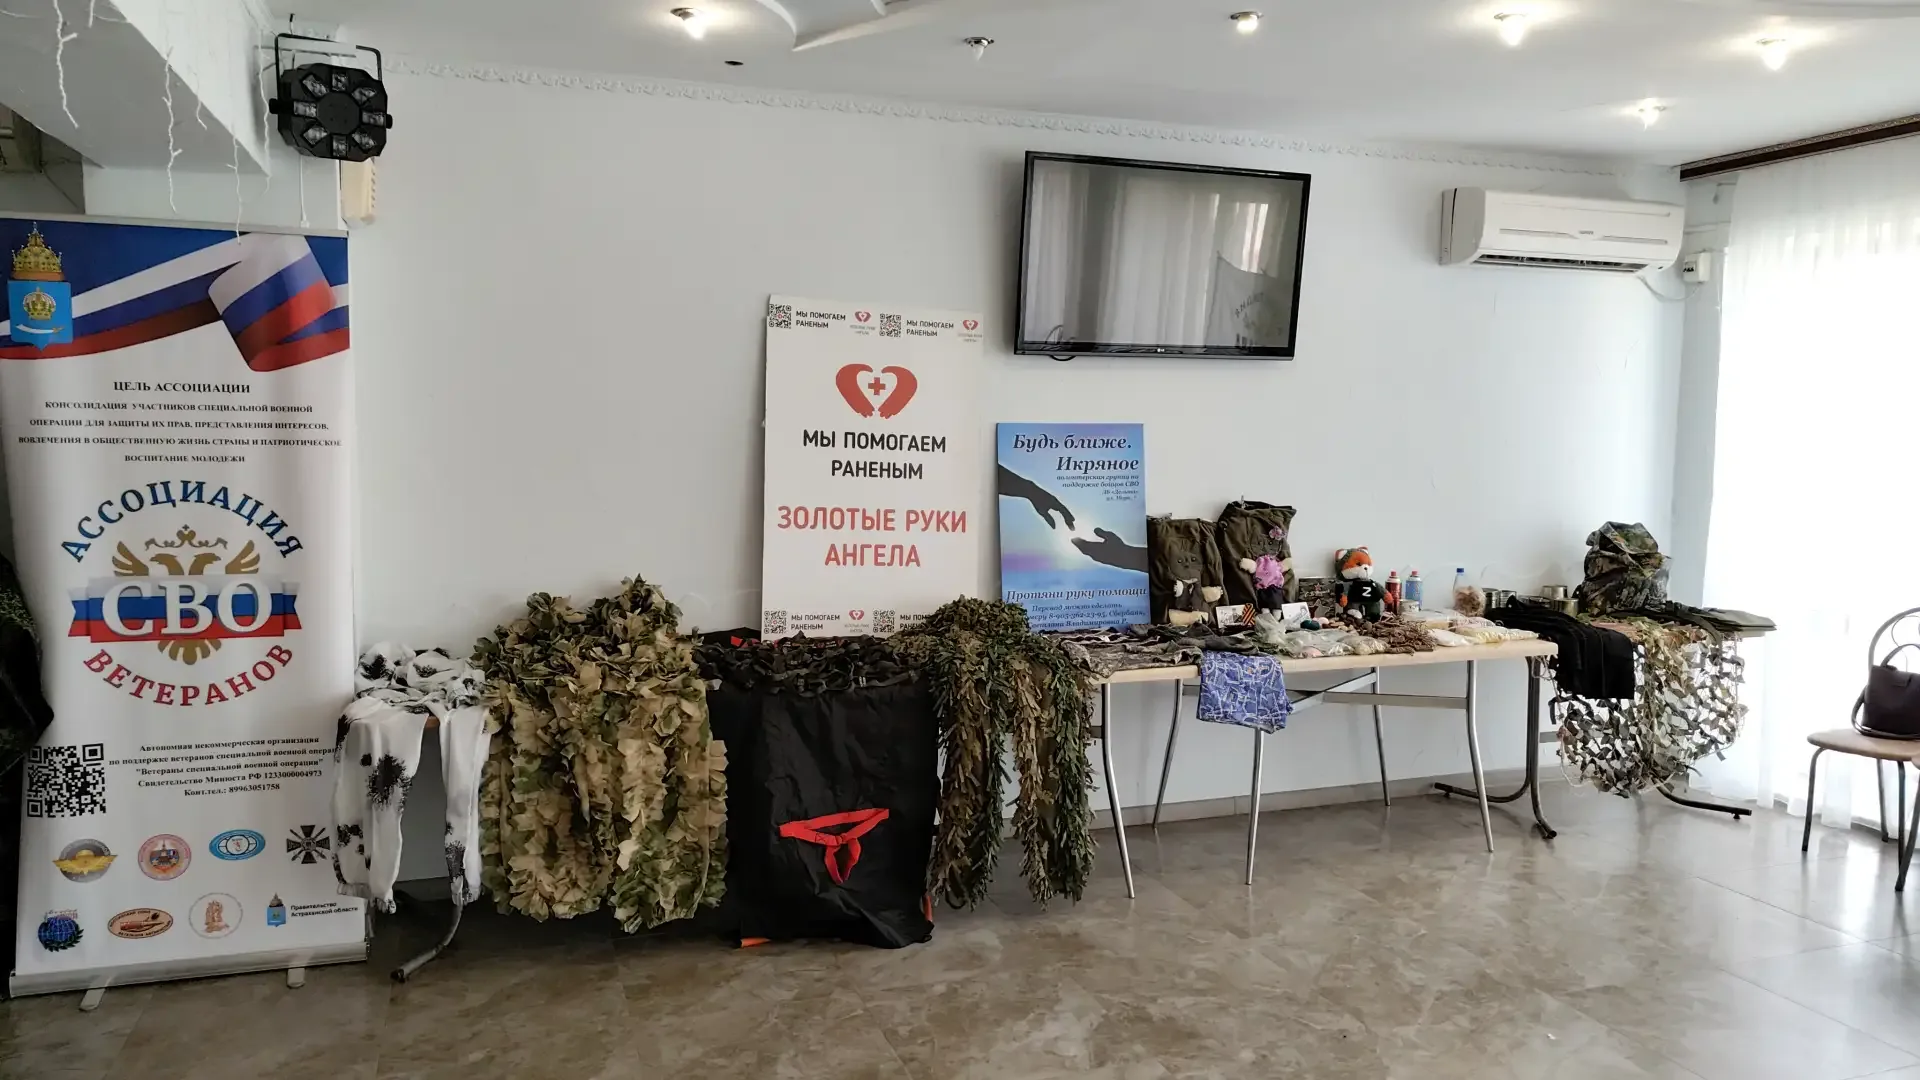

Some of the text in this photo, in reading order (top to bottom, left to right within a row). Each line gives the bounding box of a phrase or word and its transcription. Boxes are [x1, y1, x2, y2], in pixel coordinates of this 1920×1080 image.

[796, 310, 846, 321] МЫ ПОМОГАЕМ
[795, 319, 829, 329] РАНЕНЫМ
[919, 320, 954, 329] ПОМОГАЕМ
[906, 329, 938, 337] РАНЕНЫМ
[113, 381, 250, 395] ЦЕЛЬ АССОЦИАЦИИ
[45, 401, 313, 413] КОНСОЛИДАЦИЯ УЧАСТНИКОВ СПЕЦИАЛЬНОЙ ВОЕННОЙ
[29, 419, 83, 427] ОПЕРАЦИИ
[84, 419, 105, 427] ДЛЯ
[108, 420, 150, 428] ЗАЩИТЫ
[194, 421, 273, 430] ПРЕДСТАВЛЕНИЯ
[92, 437, 175, 446] ОБЩЕСТВЕННУЮ
[212, 438, 250, 446] СТРАНЫ
[260, 438, 342, 447] ПАТРИОТИЧЕСКОЕ
[803, 429, 946, 453] МЫ ПОМОГАЕМ
[1013, 434, 1132, 452] Будь ближе.
[124, 454, 245, 464] ВОСПИТАНИЕ МОЛОДЕЖИ
[1056, 456, 1139, 474] Икряное
[831, 460, 923, 480] РАНЕНЫМ
[61, 479, 303, 563] АССОЦИАЦИЯ
[777, 505, 967, 533] ЗОЛОТЫЕ РУКИ
[824, 543, 921, 568] АНГЕЛА
[1007, 587, 1147, 602] Протяни руку помощи
[1361, 586, 1372, 597] Z
[102, 578, 273, 638] СВО
[83, 644, 293, 707] ВЕТЕРАНОВ
[139, 737, 319, 752] Автономная некоммерческая организация
[122, 756, 169, 766] поддержке
[170, 753, 214, 763] ветеранов
[216, 749, 272, 760] специальной
[273, 748, 307, 757] военной
[309, 748, 335, 756] опера
[186, 763, 242, 773] специальной
[244, 760, 278, 769] военной
[138, 777, 203, 788] Свидетельство
[205, 774, 246, 784] Минюста
[248, 772, 262, 780] РФ
[228, 783, 280, 794] 89963051758
[291, 901, 337, 911] Правительство
